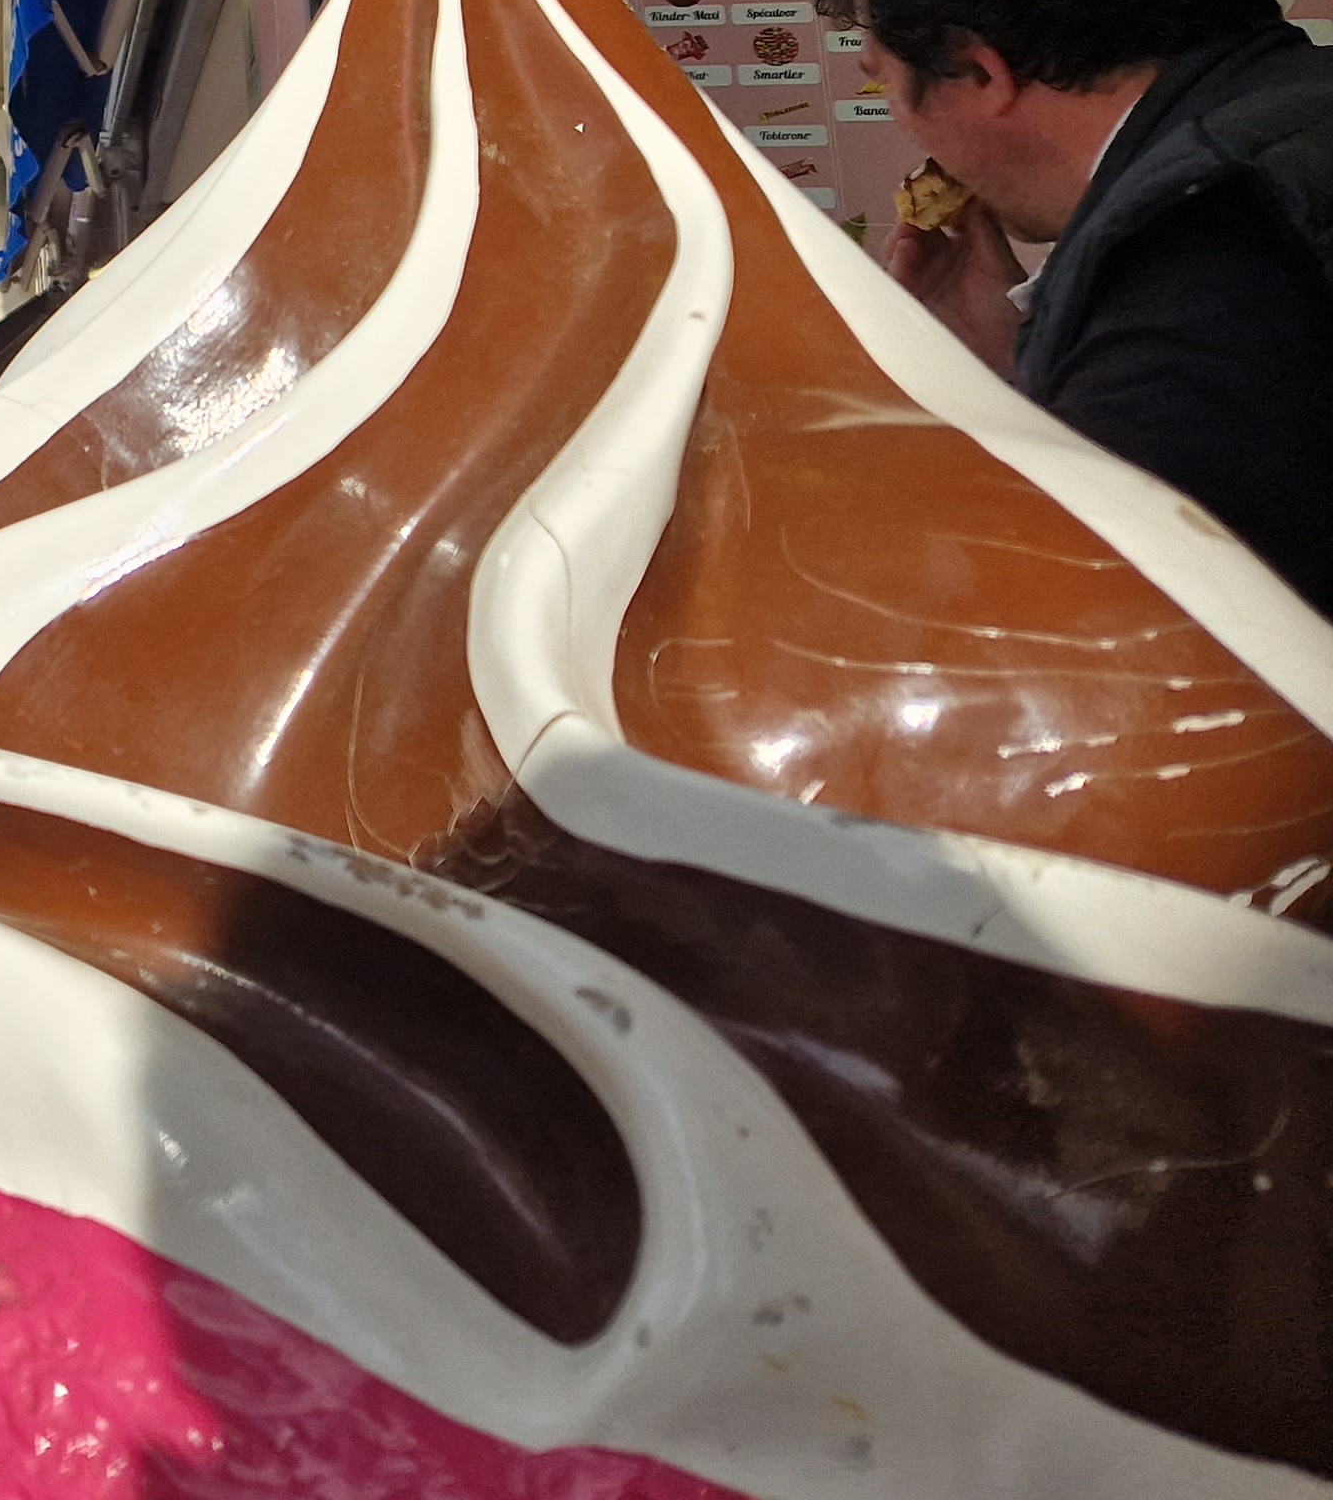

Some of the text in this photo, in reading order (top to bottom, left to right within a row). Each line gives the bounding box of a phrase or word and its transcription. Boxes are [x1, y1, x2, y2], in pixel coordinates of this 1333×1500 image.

[650, 10, 721, 21] Kinder Maxi
[746, 7, 798, 19] Spéculoos
[753, 69, 806, 80] Smarties
[759, 130, 812, 141] Toblerone
